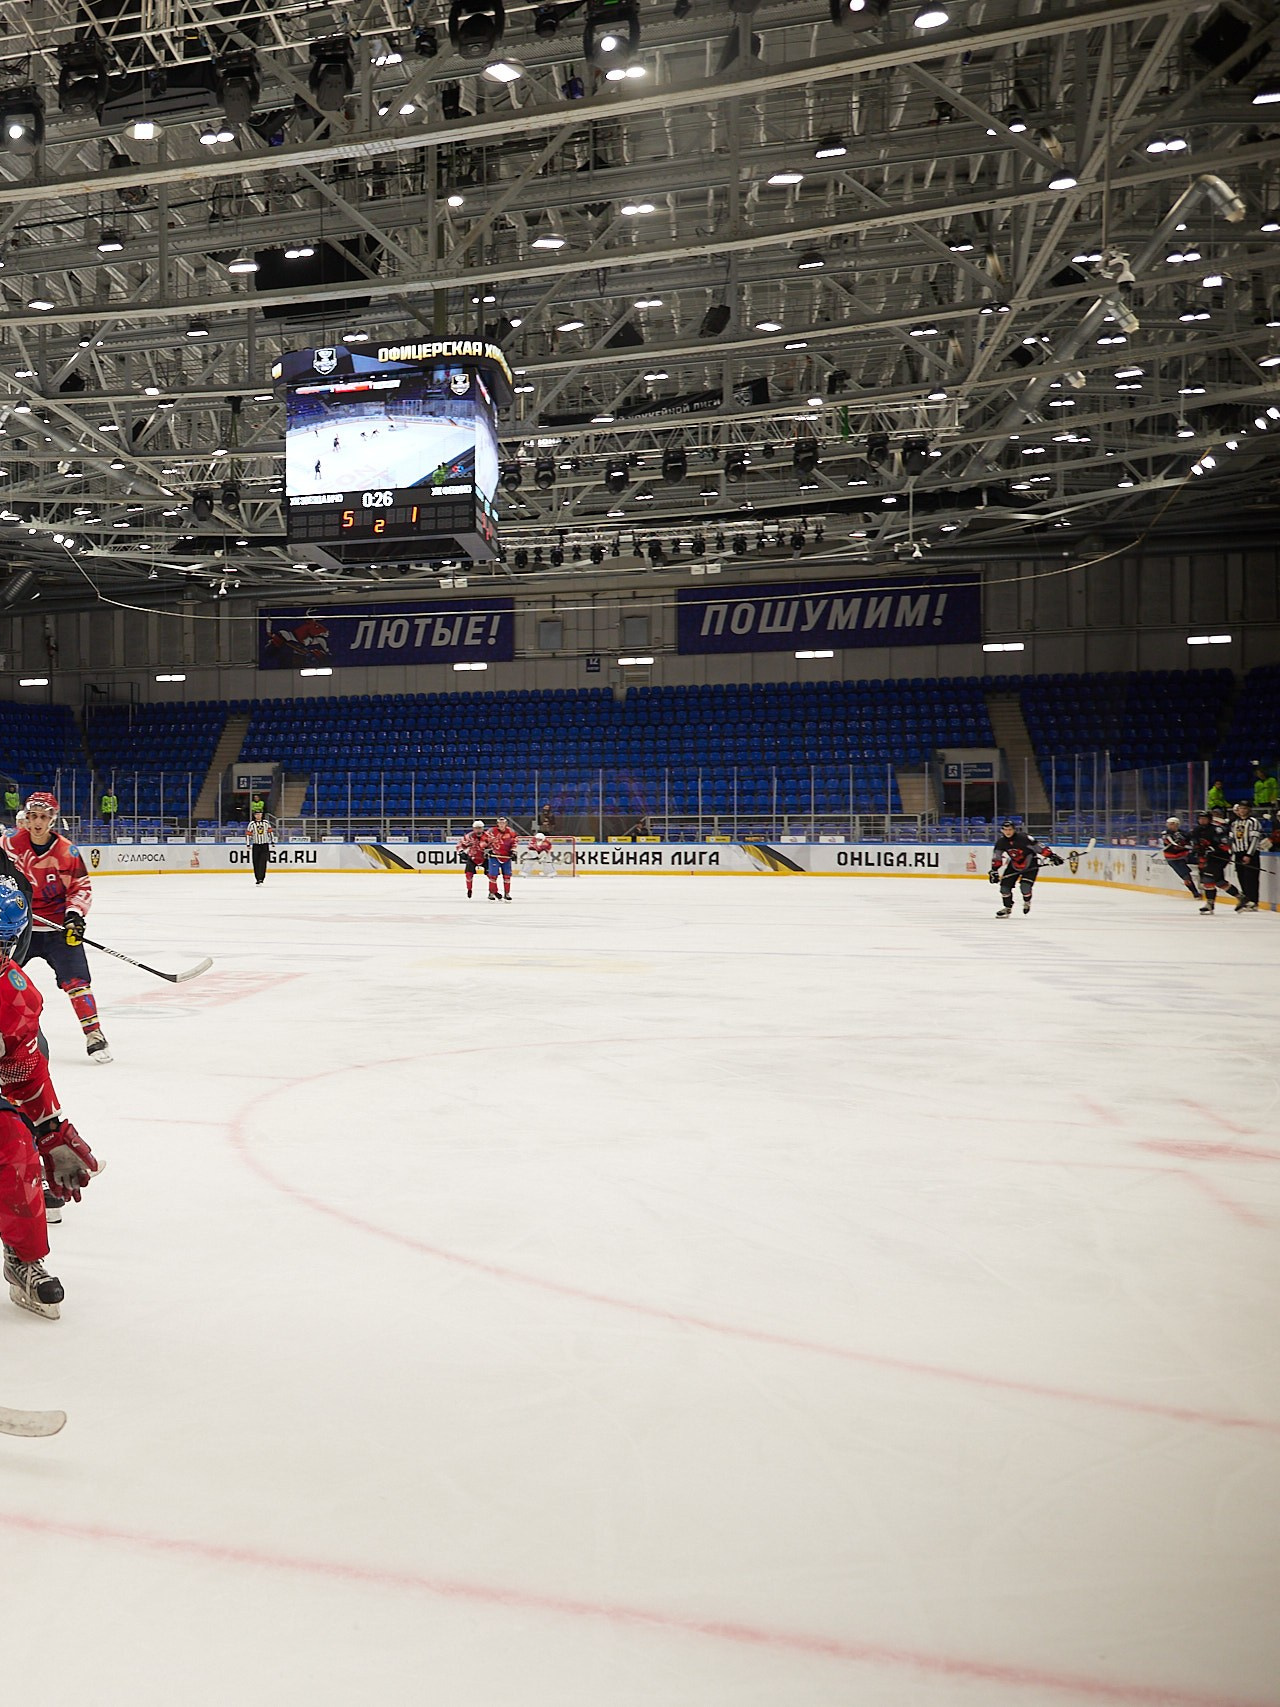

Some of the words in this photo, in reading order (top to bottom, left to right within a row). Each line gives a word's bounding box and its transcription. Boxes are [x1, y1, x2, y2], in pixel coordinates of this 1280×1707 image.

[378, 341, 483, 363] ОФИЦЕРСКАЯ
[361, 491, 394, 508] 0:26
[342, 510, 355, 528] 5
[411, 506, 418, 523] 1
[373, 519, 386, 533] 2
[700, 593, 948, 636] ПОШУМИМ!
[349, 614, 501, 650] ЛЮТЫЕ!
[229, 850, 318, 864] OHGA.RU
[670, 850, 721, 866] ЛИГА
[836, 851, 940, 868] OHLIGA.RU
